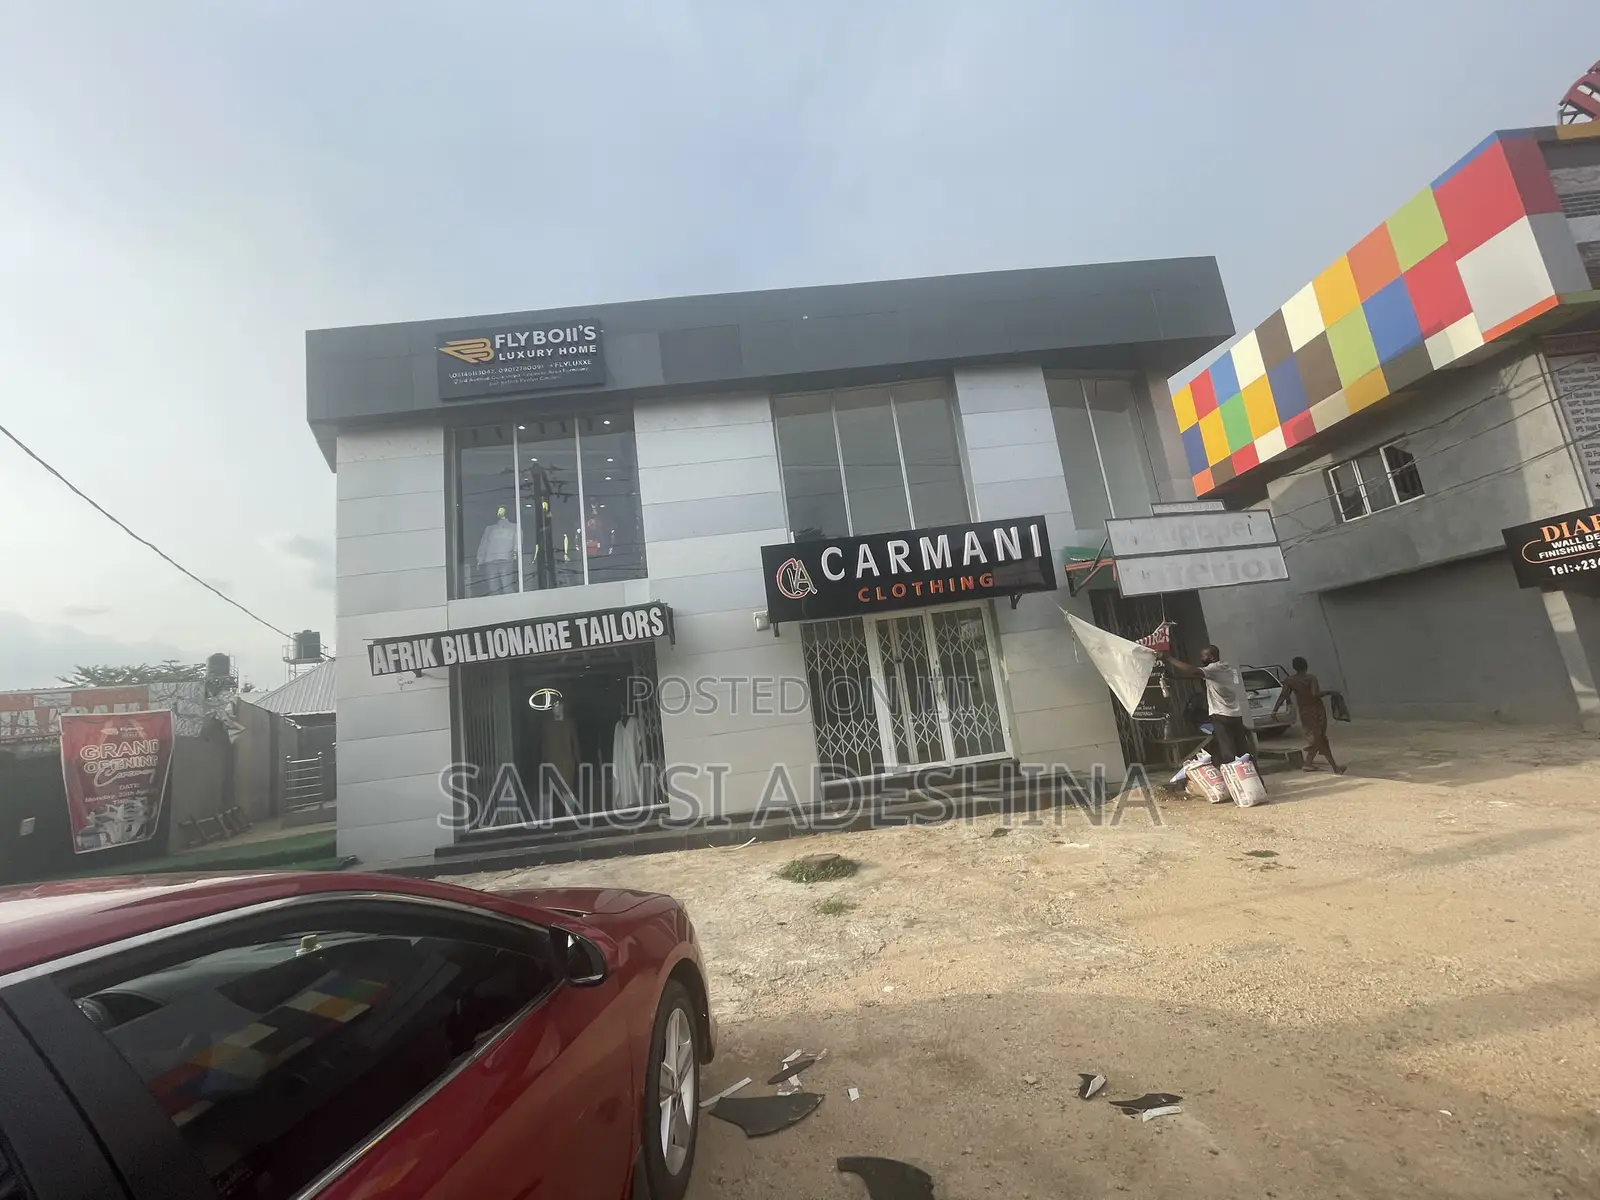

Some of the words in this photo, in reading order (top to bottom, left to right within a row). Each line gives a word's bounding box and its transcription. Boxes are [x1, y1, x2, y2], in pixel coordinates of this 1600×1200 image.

[495, 324, 596, 349] FLYBOII'S
[499, 348, 554, 361] LUXURY
[559, 345, 597, 355] HOME
[820, 523, 1042, 582] CARMANI
[1538, 542, 1595, 559] FINISHING
[1551, 537, 1583, 549] WALL
[857, 572, 994, 603] CLOTHING
[372, 638, 437, 675] AFRIK
[441, 620, 572, 666] BILLIONAIRE
[575, 606, 664, 647] TAILORS
[80, 738, 159, 761] GRAND
